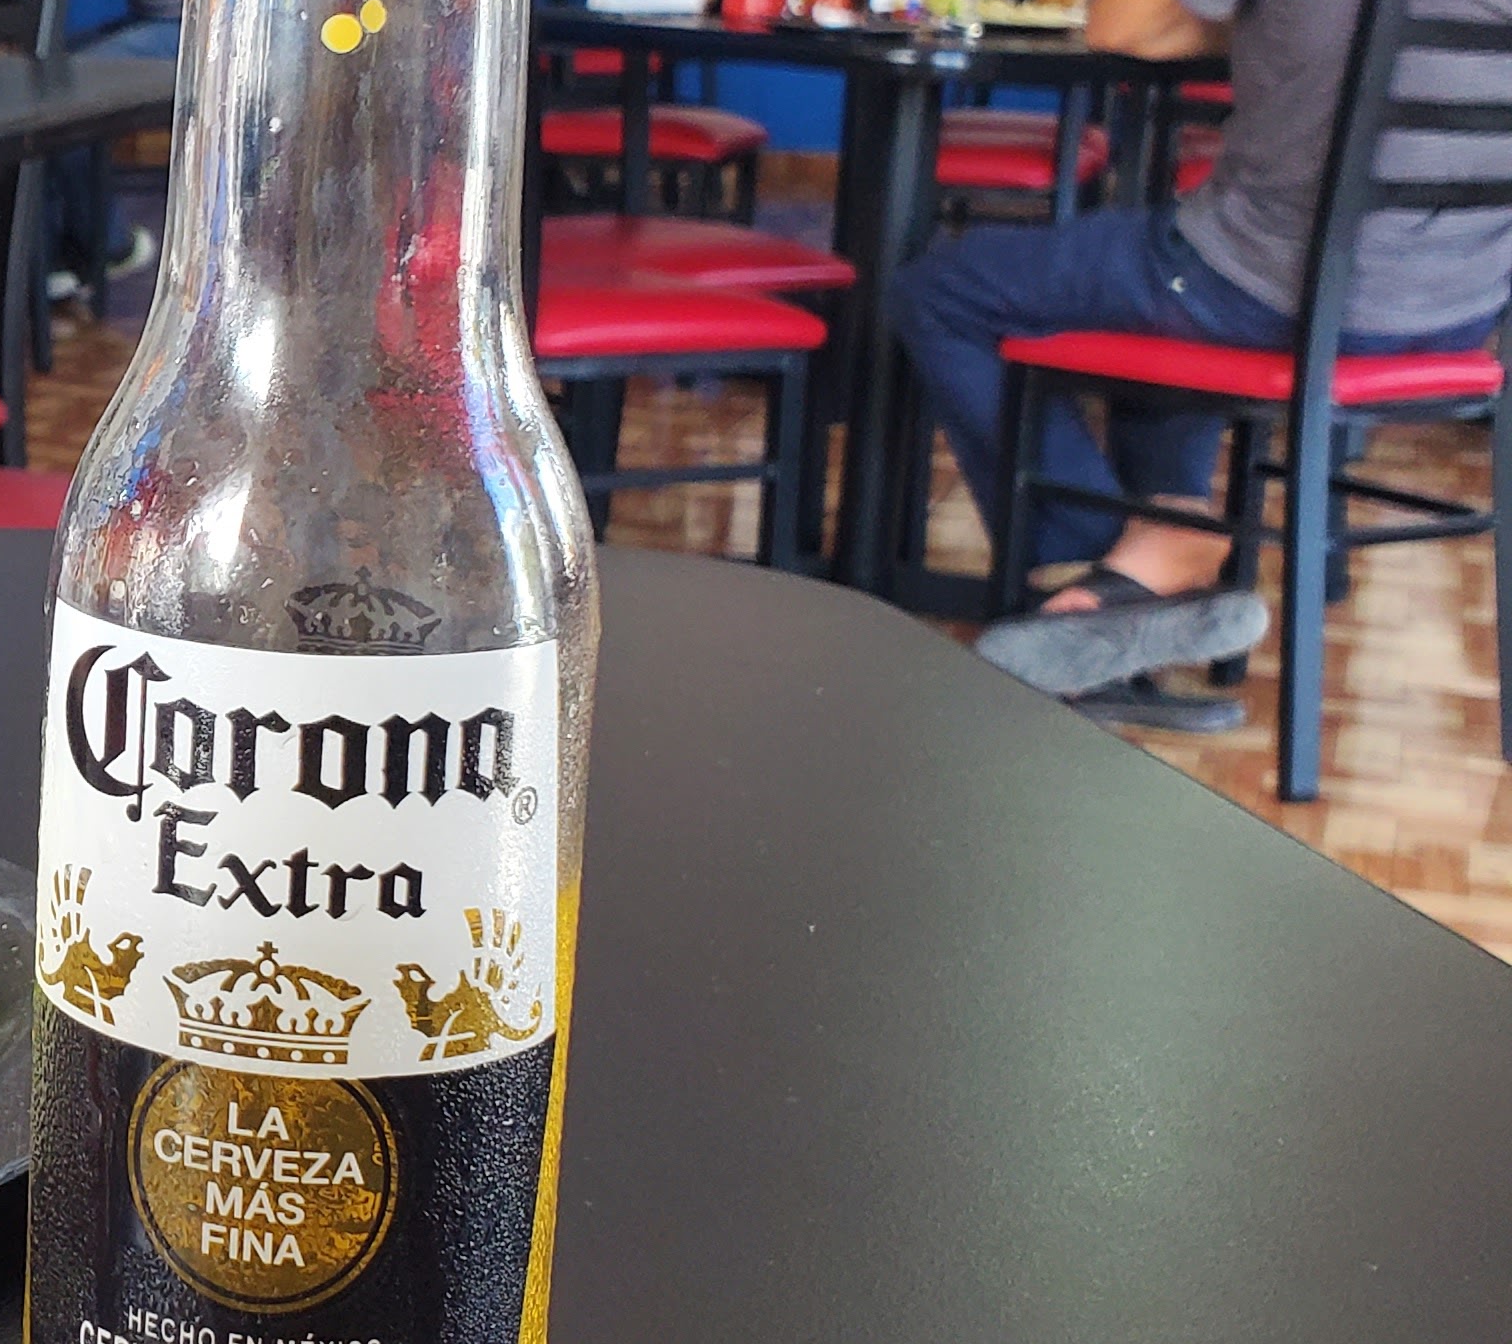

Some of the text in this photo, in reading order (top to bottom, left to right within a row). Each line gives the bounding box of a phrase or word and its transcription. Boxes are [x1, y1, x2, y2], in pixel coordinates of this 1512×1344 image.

[65, 644, 521, 822] Corona
[152, 801, 427, 919] Extra
[227, 1101, 290, 1141] LA
[153, 1128, 366, 1185] CERVEZA
[205, 1181, 306, 1226] MÁS
[201, 1222, 306, 1268] FINA
